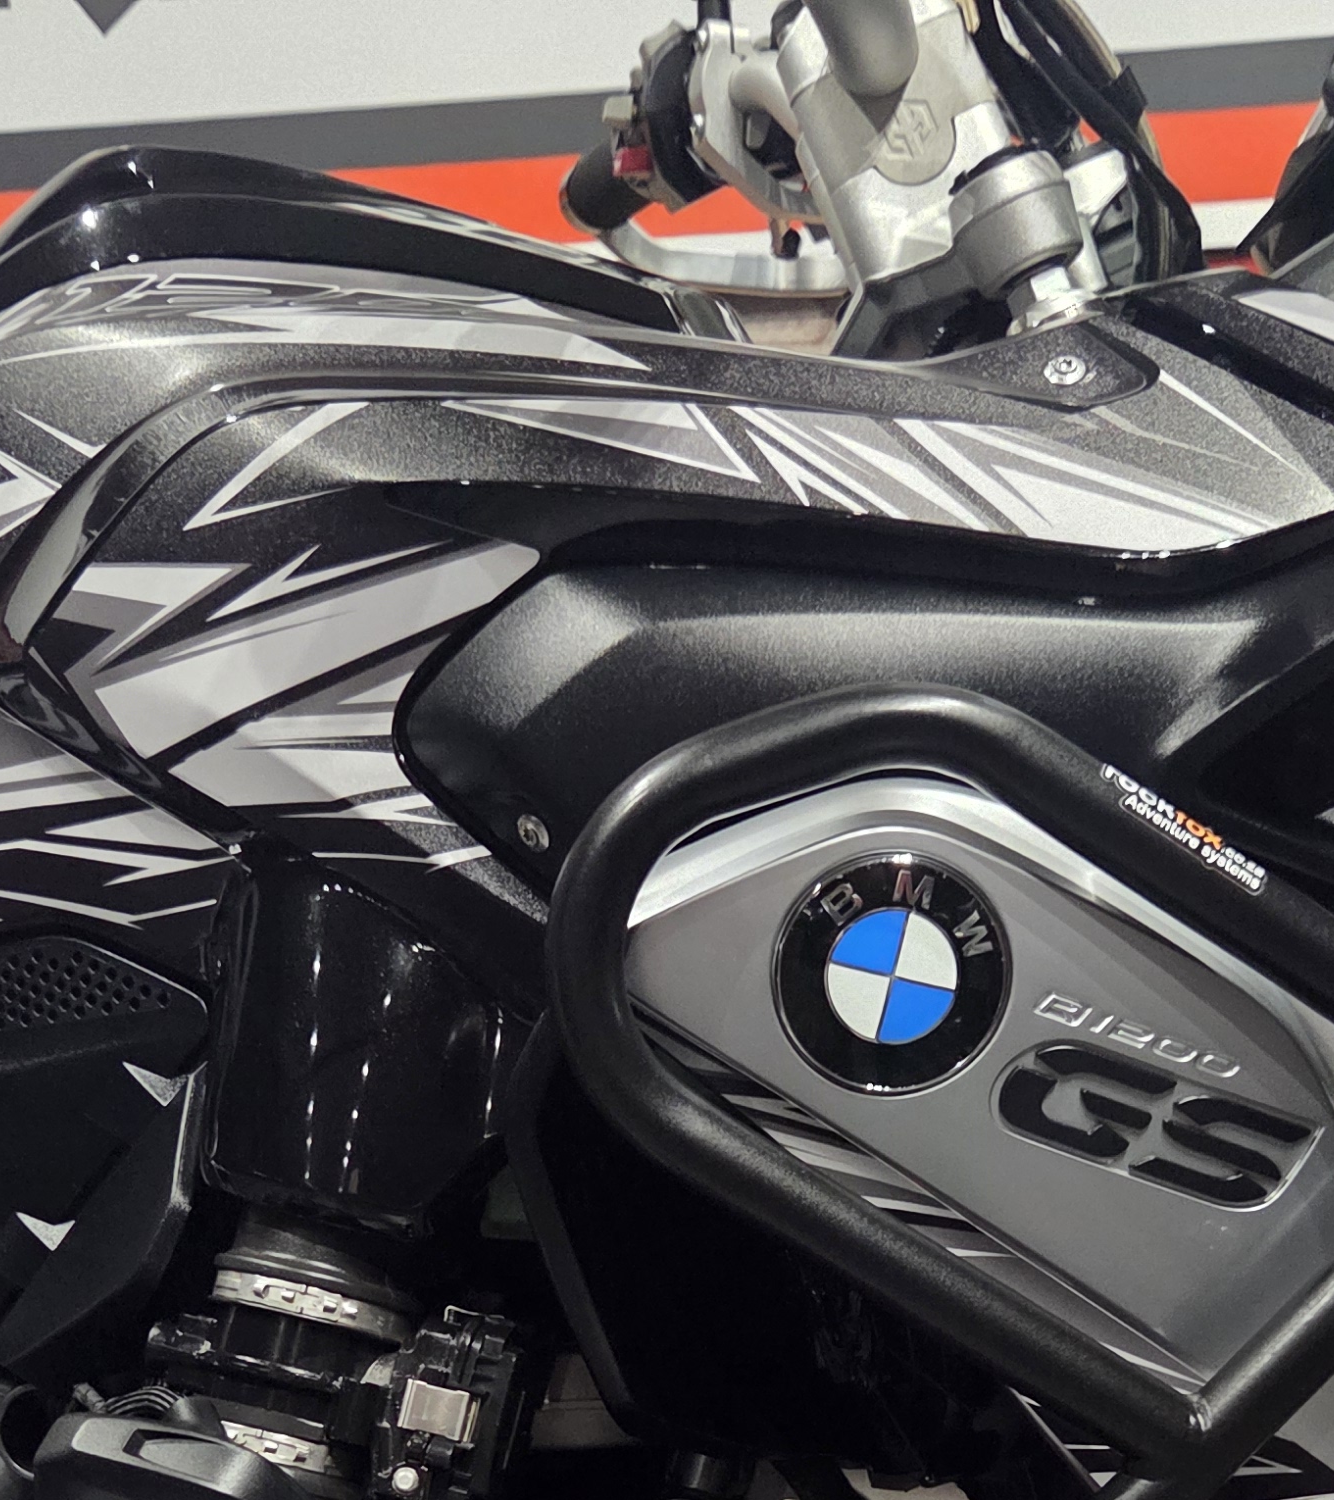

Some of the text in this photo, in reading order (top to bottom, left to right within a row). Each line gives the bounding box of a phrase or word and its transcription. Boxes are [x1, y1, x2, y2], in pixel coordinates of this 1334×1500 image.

[1124, 795, 1262, 891] Adventure systems
[820, 869, 994, 958] BMW
[1033, 992, 1241, 1078] R1200
[998, 1042, 1313, 1204] GS
